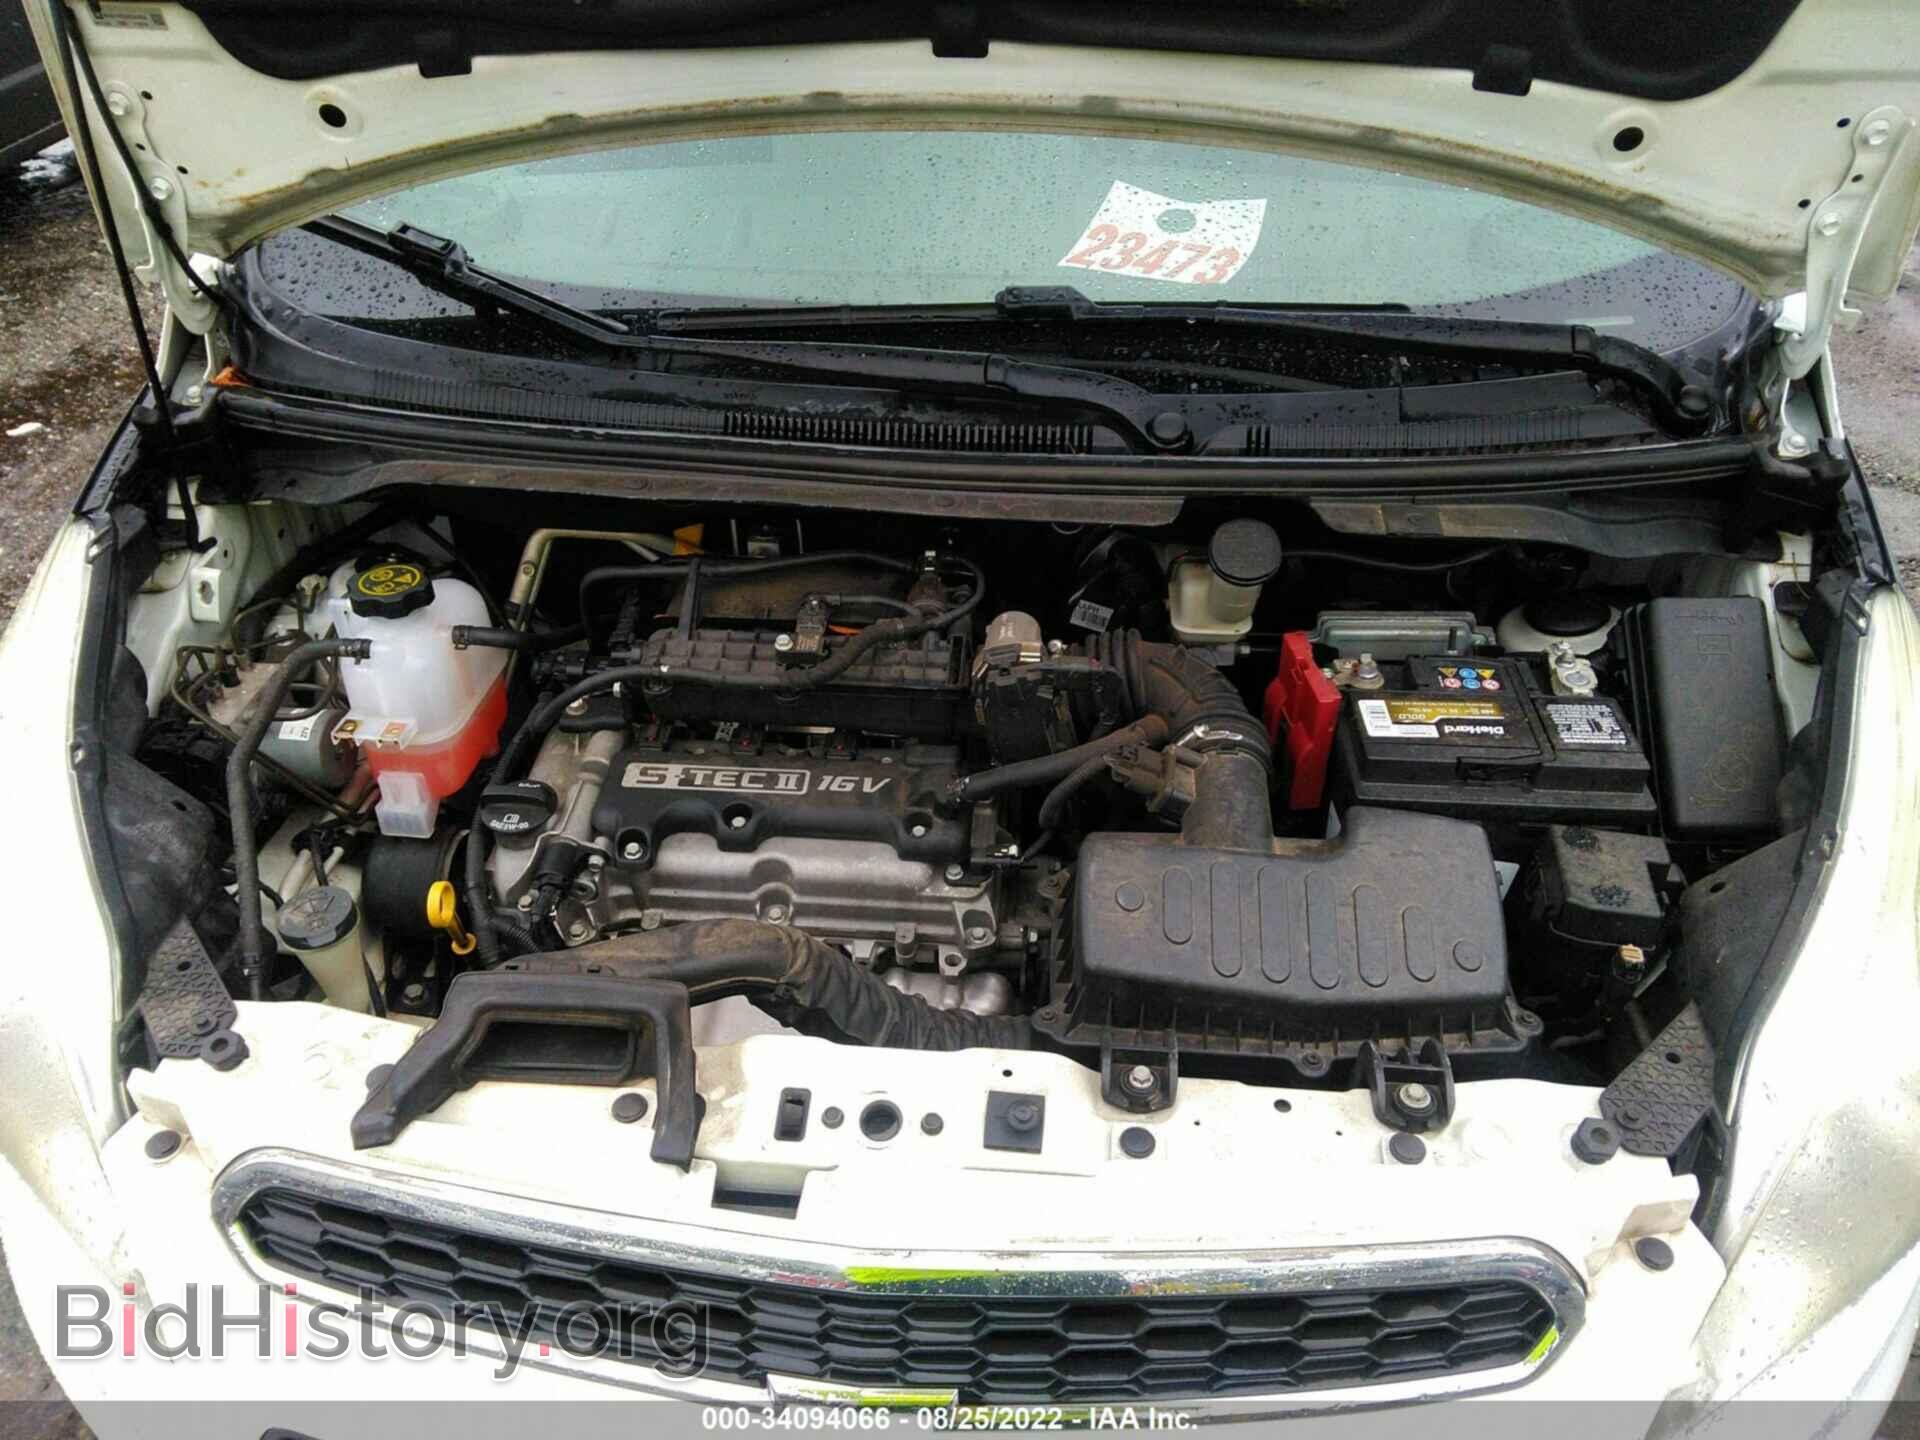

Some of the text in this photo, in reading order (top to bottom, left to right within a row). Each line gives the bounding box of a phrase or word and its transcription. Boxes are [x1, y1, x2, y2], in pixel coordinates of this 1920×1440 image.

[1066, 223, 1240, 284] 23473
[1444, 724, 1505, 735] DieHard
[817, 775, 892, 793] 16V
